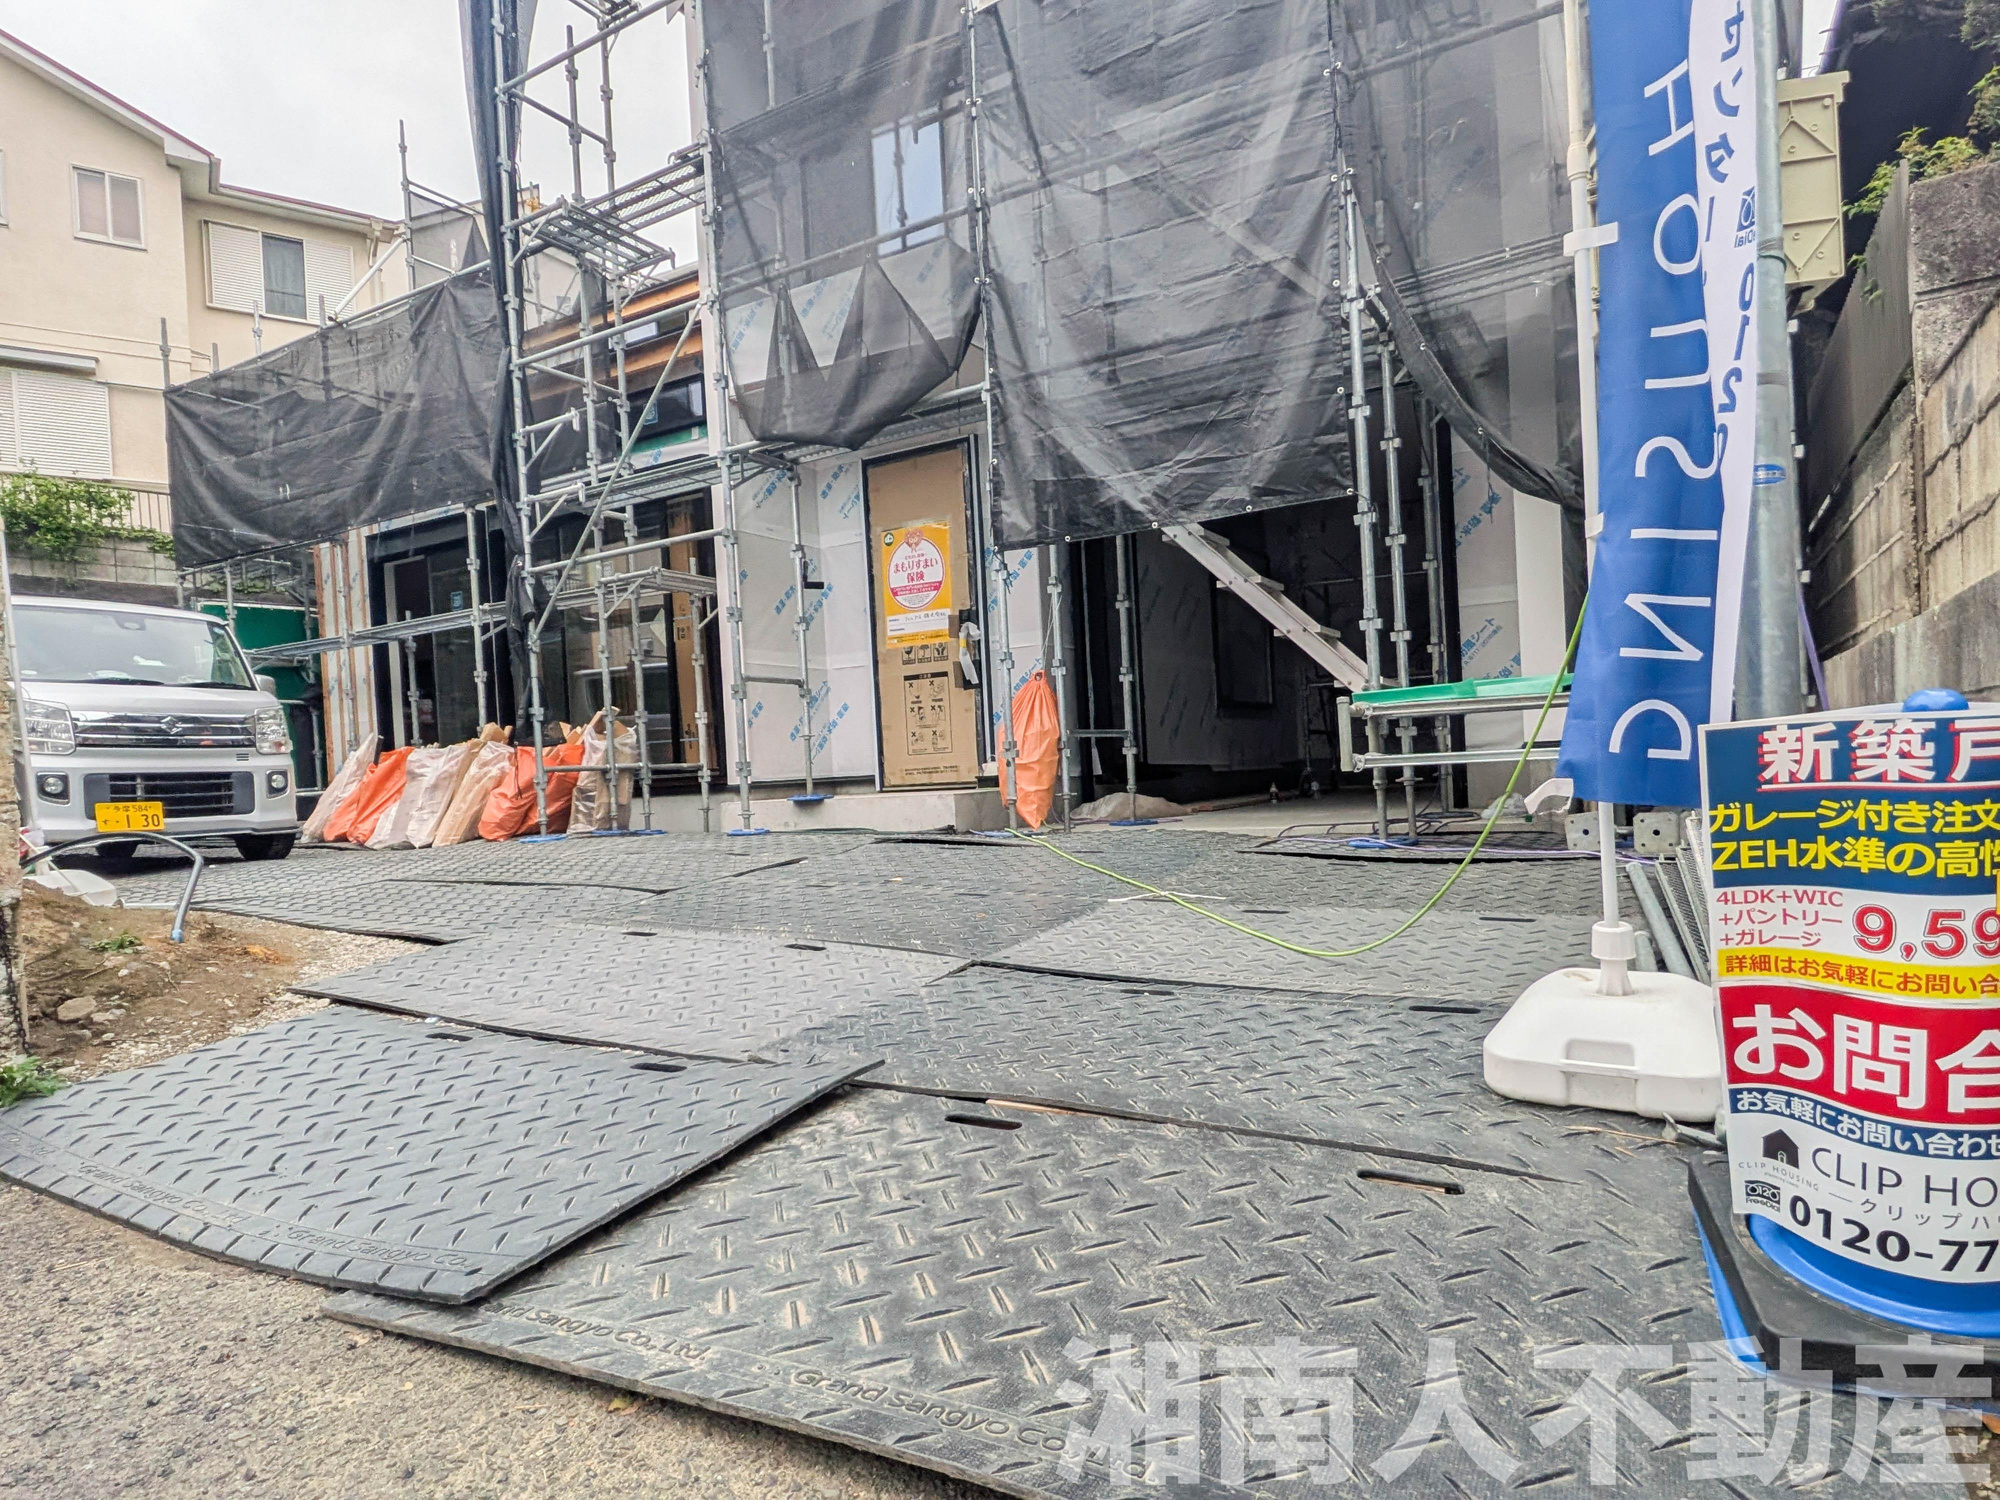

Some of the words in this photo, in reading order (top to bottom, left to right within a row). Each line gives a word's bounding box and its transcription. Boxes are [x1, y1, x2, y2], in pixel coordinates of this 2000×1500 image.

[893, 557, 938, 574] まもりすまい
[906, 571, 925, 584] 保険
[1758, 718, 2000, 783] 新築戸
[1709, 798, 2000, 834] ガレージ付き注文
[1716, 889, 1843, 907] 4LDK+WIC
[1718, 908, 1843, 927] +パントリー
[1720, 929, 1822, 948] +ガレージ
[1725, 954, 2000, 994] 詳細はお気軽にお問い合
[1732, 1003, 2000, 1114] お問合
[1738, 1161, 1766, 1169] CLIP
[1772, 1165, 1819, 1191] HOUSING
[1812, 1147, 1903, 1195] CLIP
[1924, 1174, 1998, 1208] HO
[1860, 1198, 2000, 1230] クリップハ
[1788, 1194, 1999, 1273] 0120-77
[525, 1308, 614, 1337] Sangyo
[793, 1367, 888, 1402] Grand
[884, 1391, 1010, 1437] Sangyo
